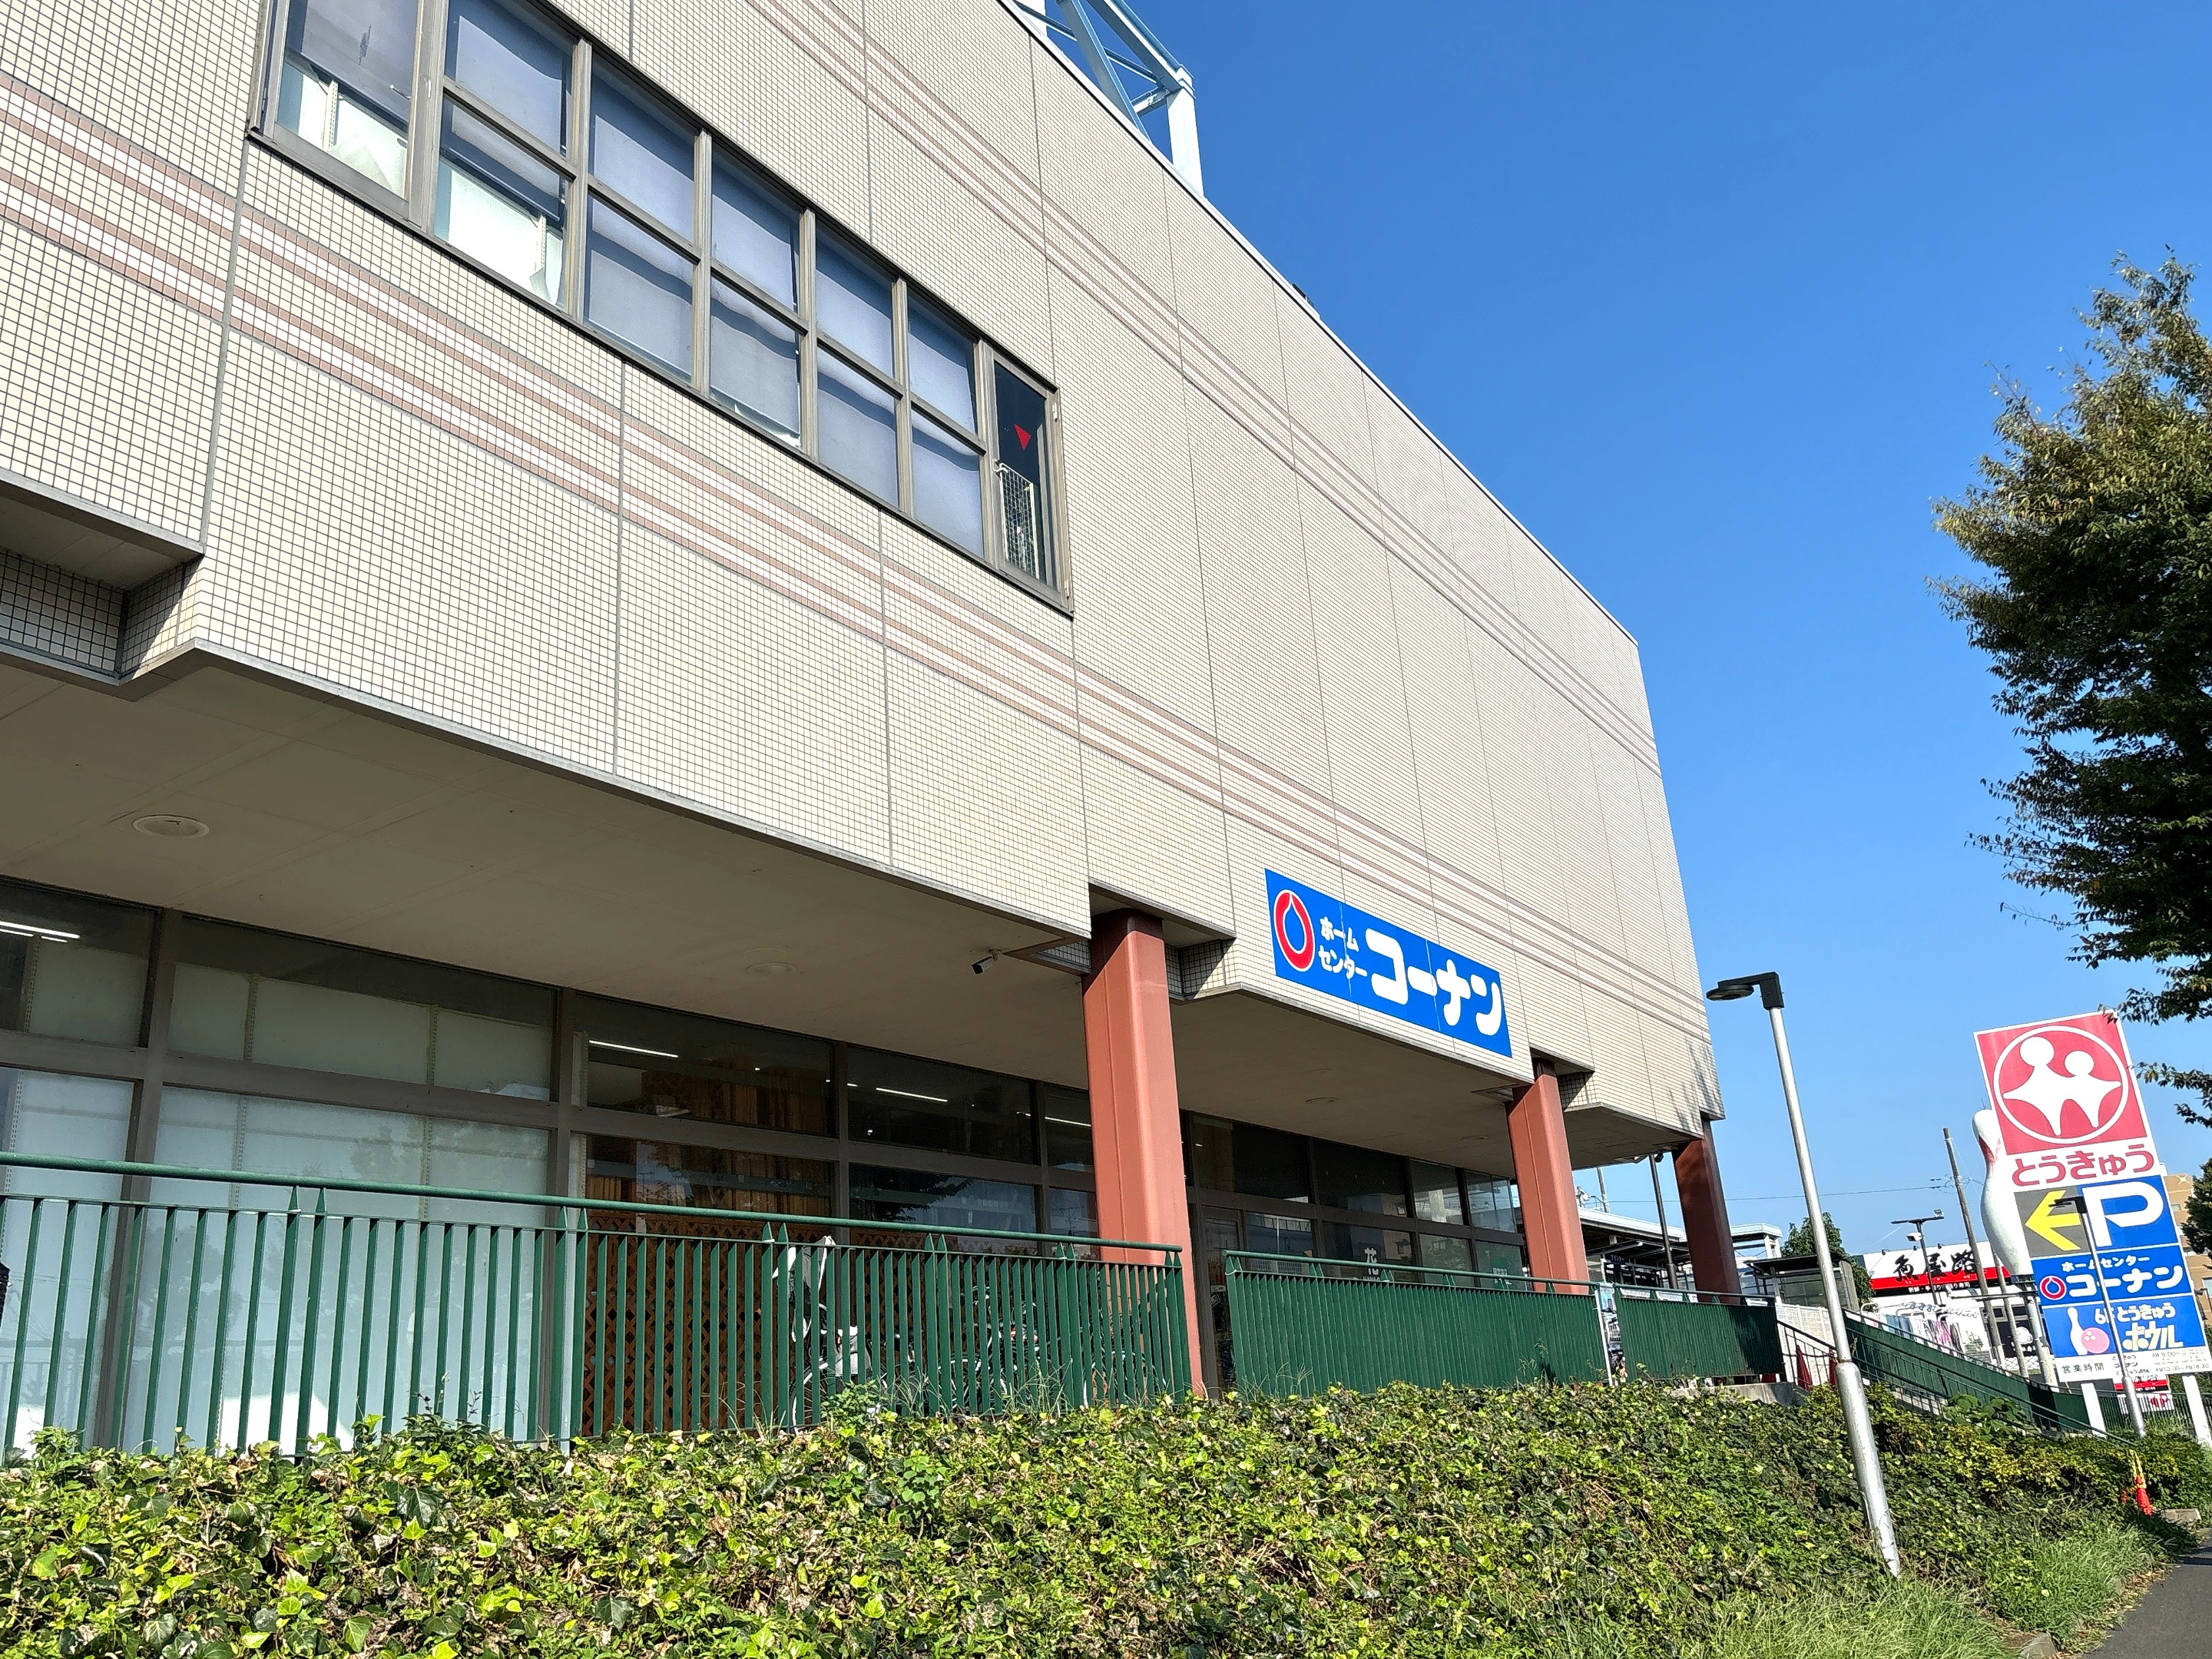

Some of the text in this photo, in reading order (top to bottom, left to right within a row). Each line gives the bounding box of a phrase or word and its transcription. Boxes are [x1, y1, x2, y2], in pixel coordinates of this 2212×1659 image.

[1320, 916, 1359, 952] ホーム
[1319, 945, 1367, 979] センター
[1365, 928, 1502, 1036] コーナン
[2012, 1144, 2154, 1187] とうきゅう
[2081, 1181, 2164, 1247] P
[2061, 1254, 2150, 1272] ホームセンター
[2066, 1265, 2183, 1297] コーナン
[2117, 1303, 2176, 1323] とうきゅう
[2122, 1320, 2184, 1351] ボウル
[2061, 1363, 2104, 1374] 営業時間
